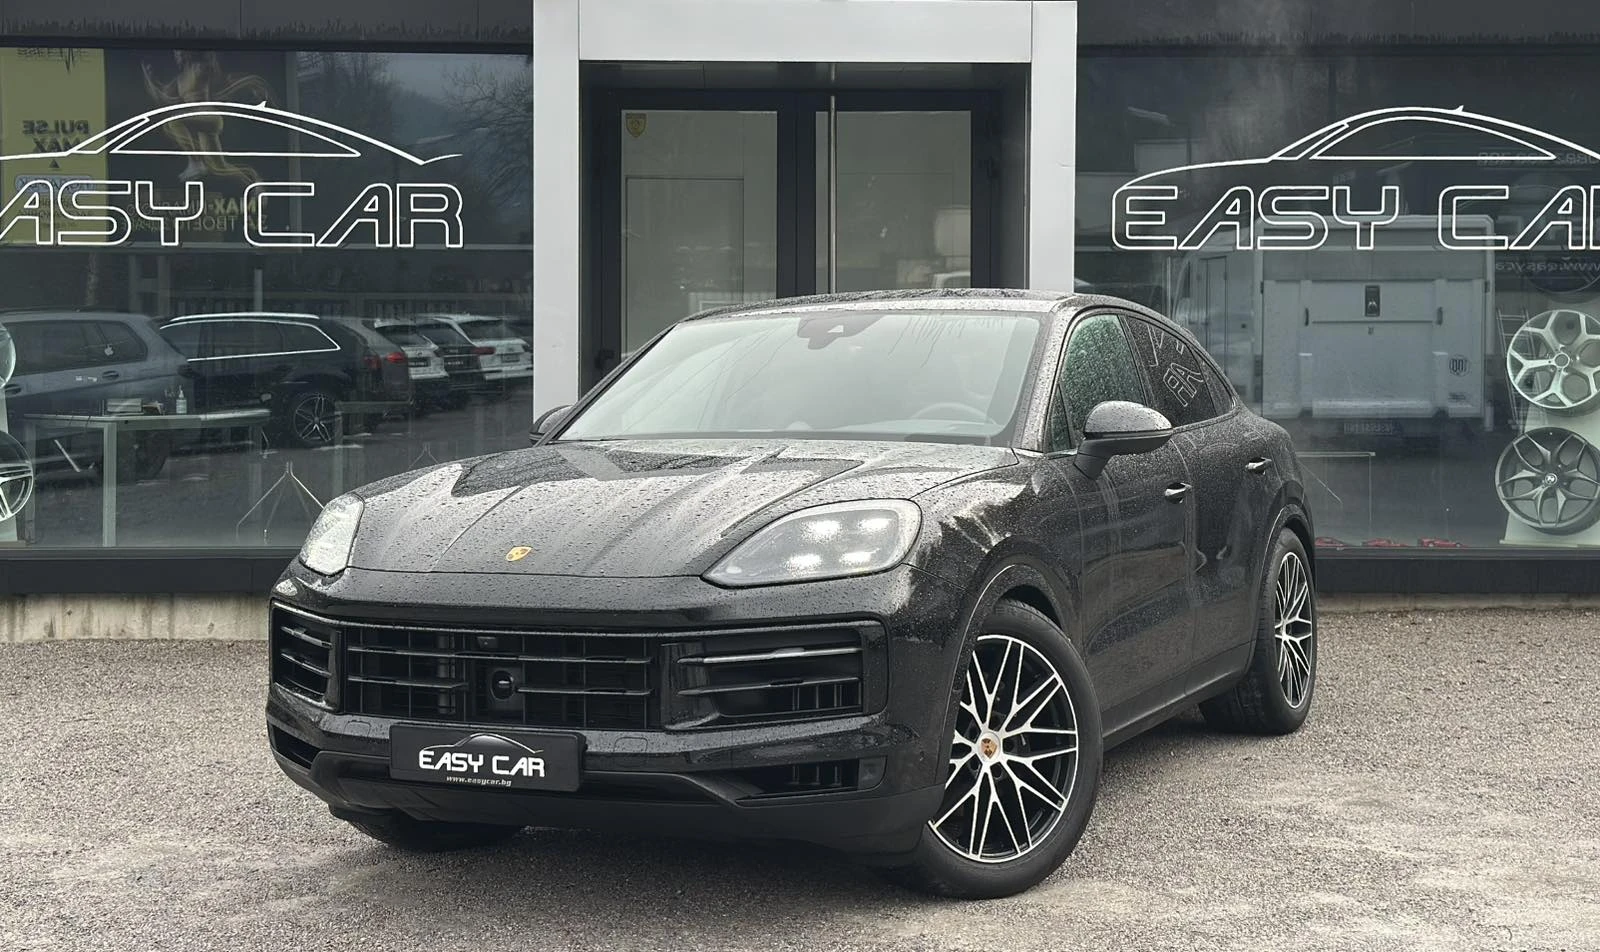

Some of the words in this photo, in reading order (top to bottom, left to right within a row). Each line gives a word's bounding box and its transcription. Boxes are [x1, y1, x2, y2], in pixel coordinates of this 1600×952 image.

[244, 182, 463, 248] CAR
[1112, 185, 1400, 250] EASY
[1438, 185, 1600, 250] CA
[418, 750, 484, 773] EASY
[491, 755, 546, 778] CAR
[446, 775, 512, 787] www.easycar.bg
